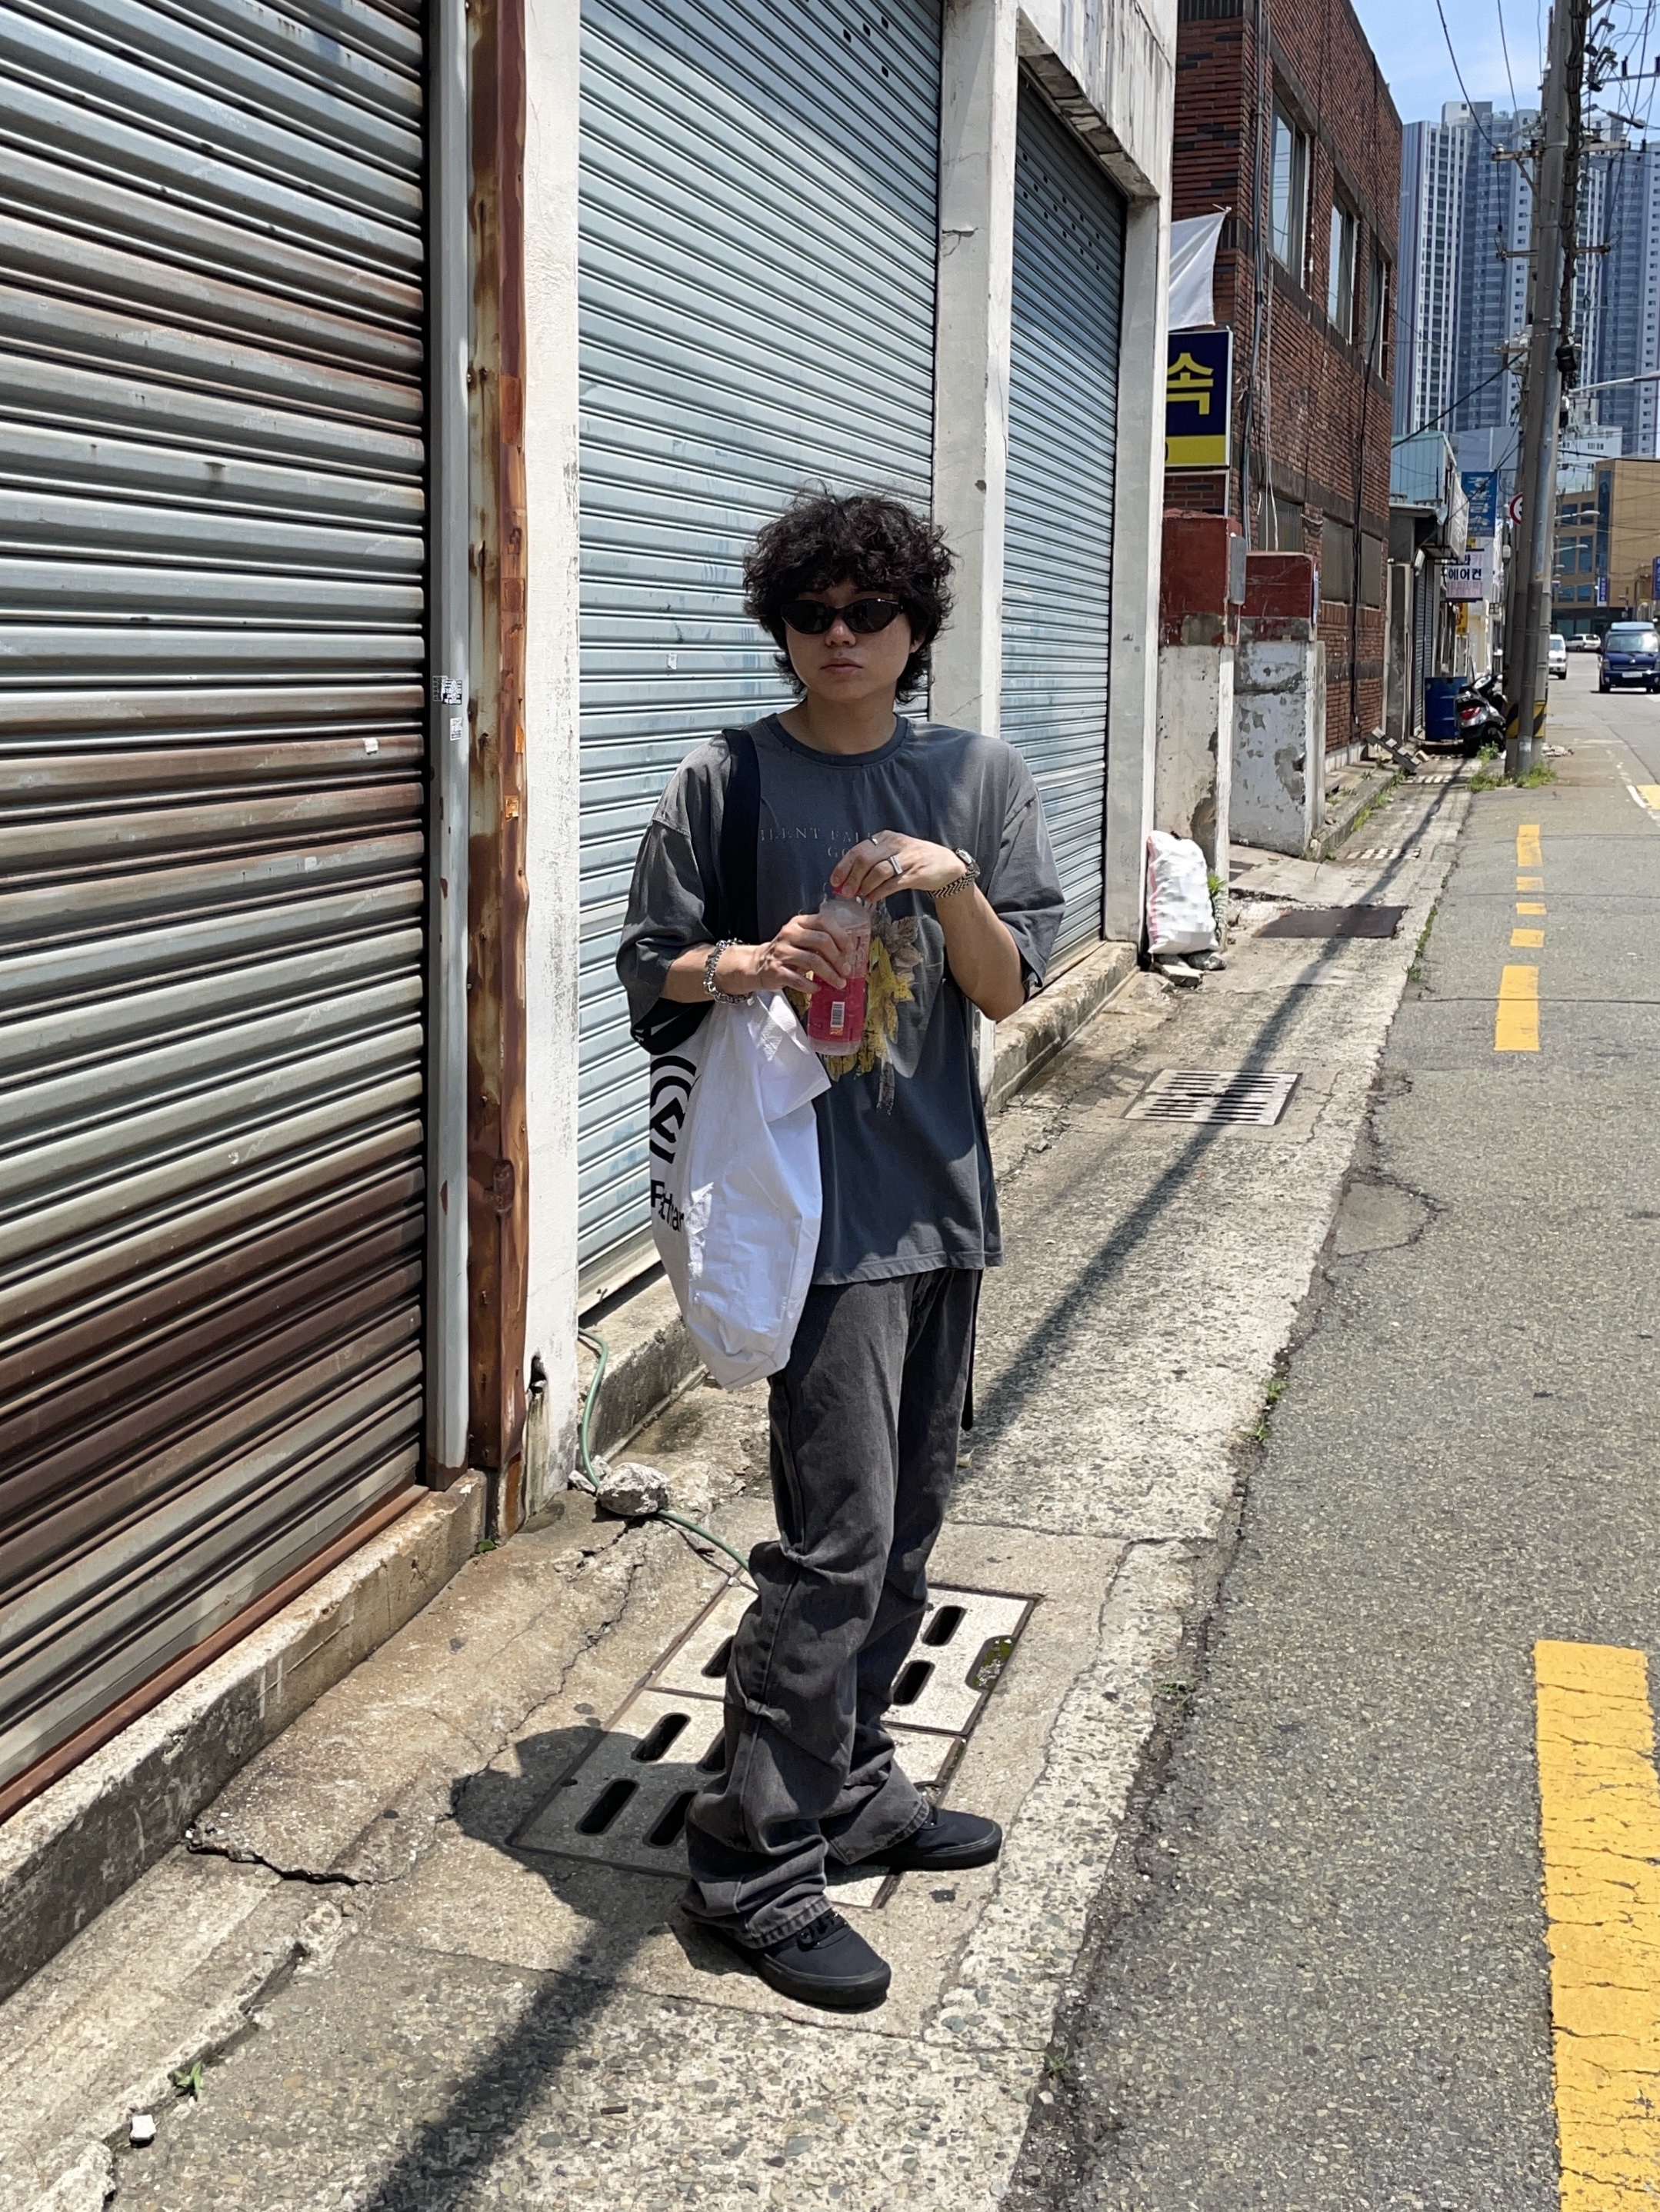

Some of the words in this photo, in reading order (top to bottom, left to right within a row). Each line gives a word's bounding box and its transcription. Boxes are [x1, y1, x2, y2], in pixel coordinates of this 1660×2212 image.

[1166, 351, 1214, 416] 속
[1448, 568, 1482, 581] 에어컨
[760, 827, 820, 841] ILENT
